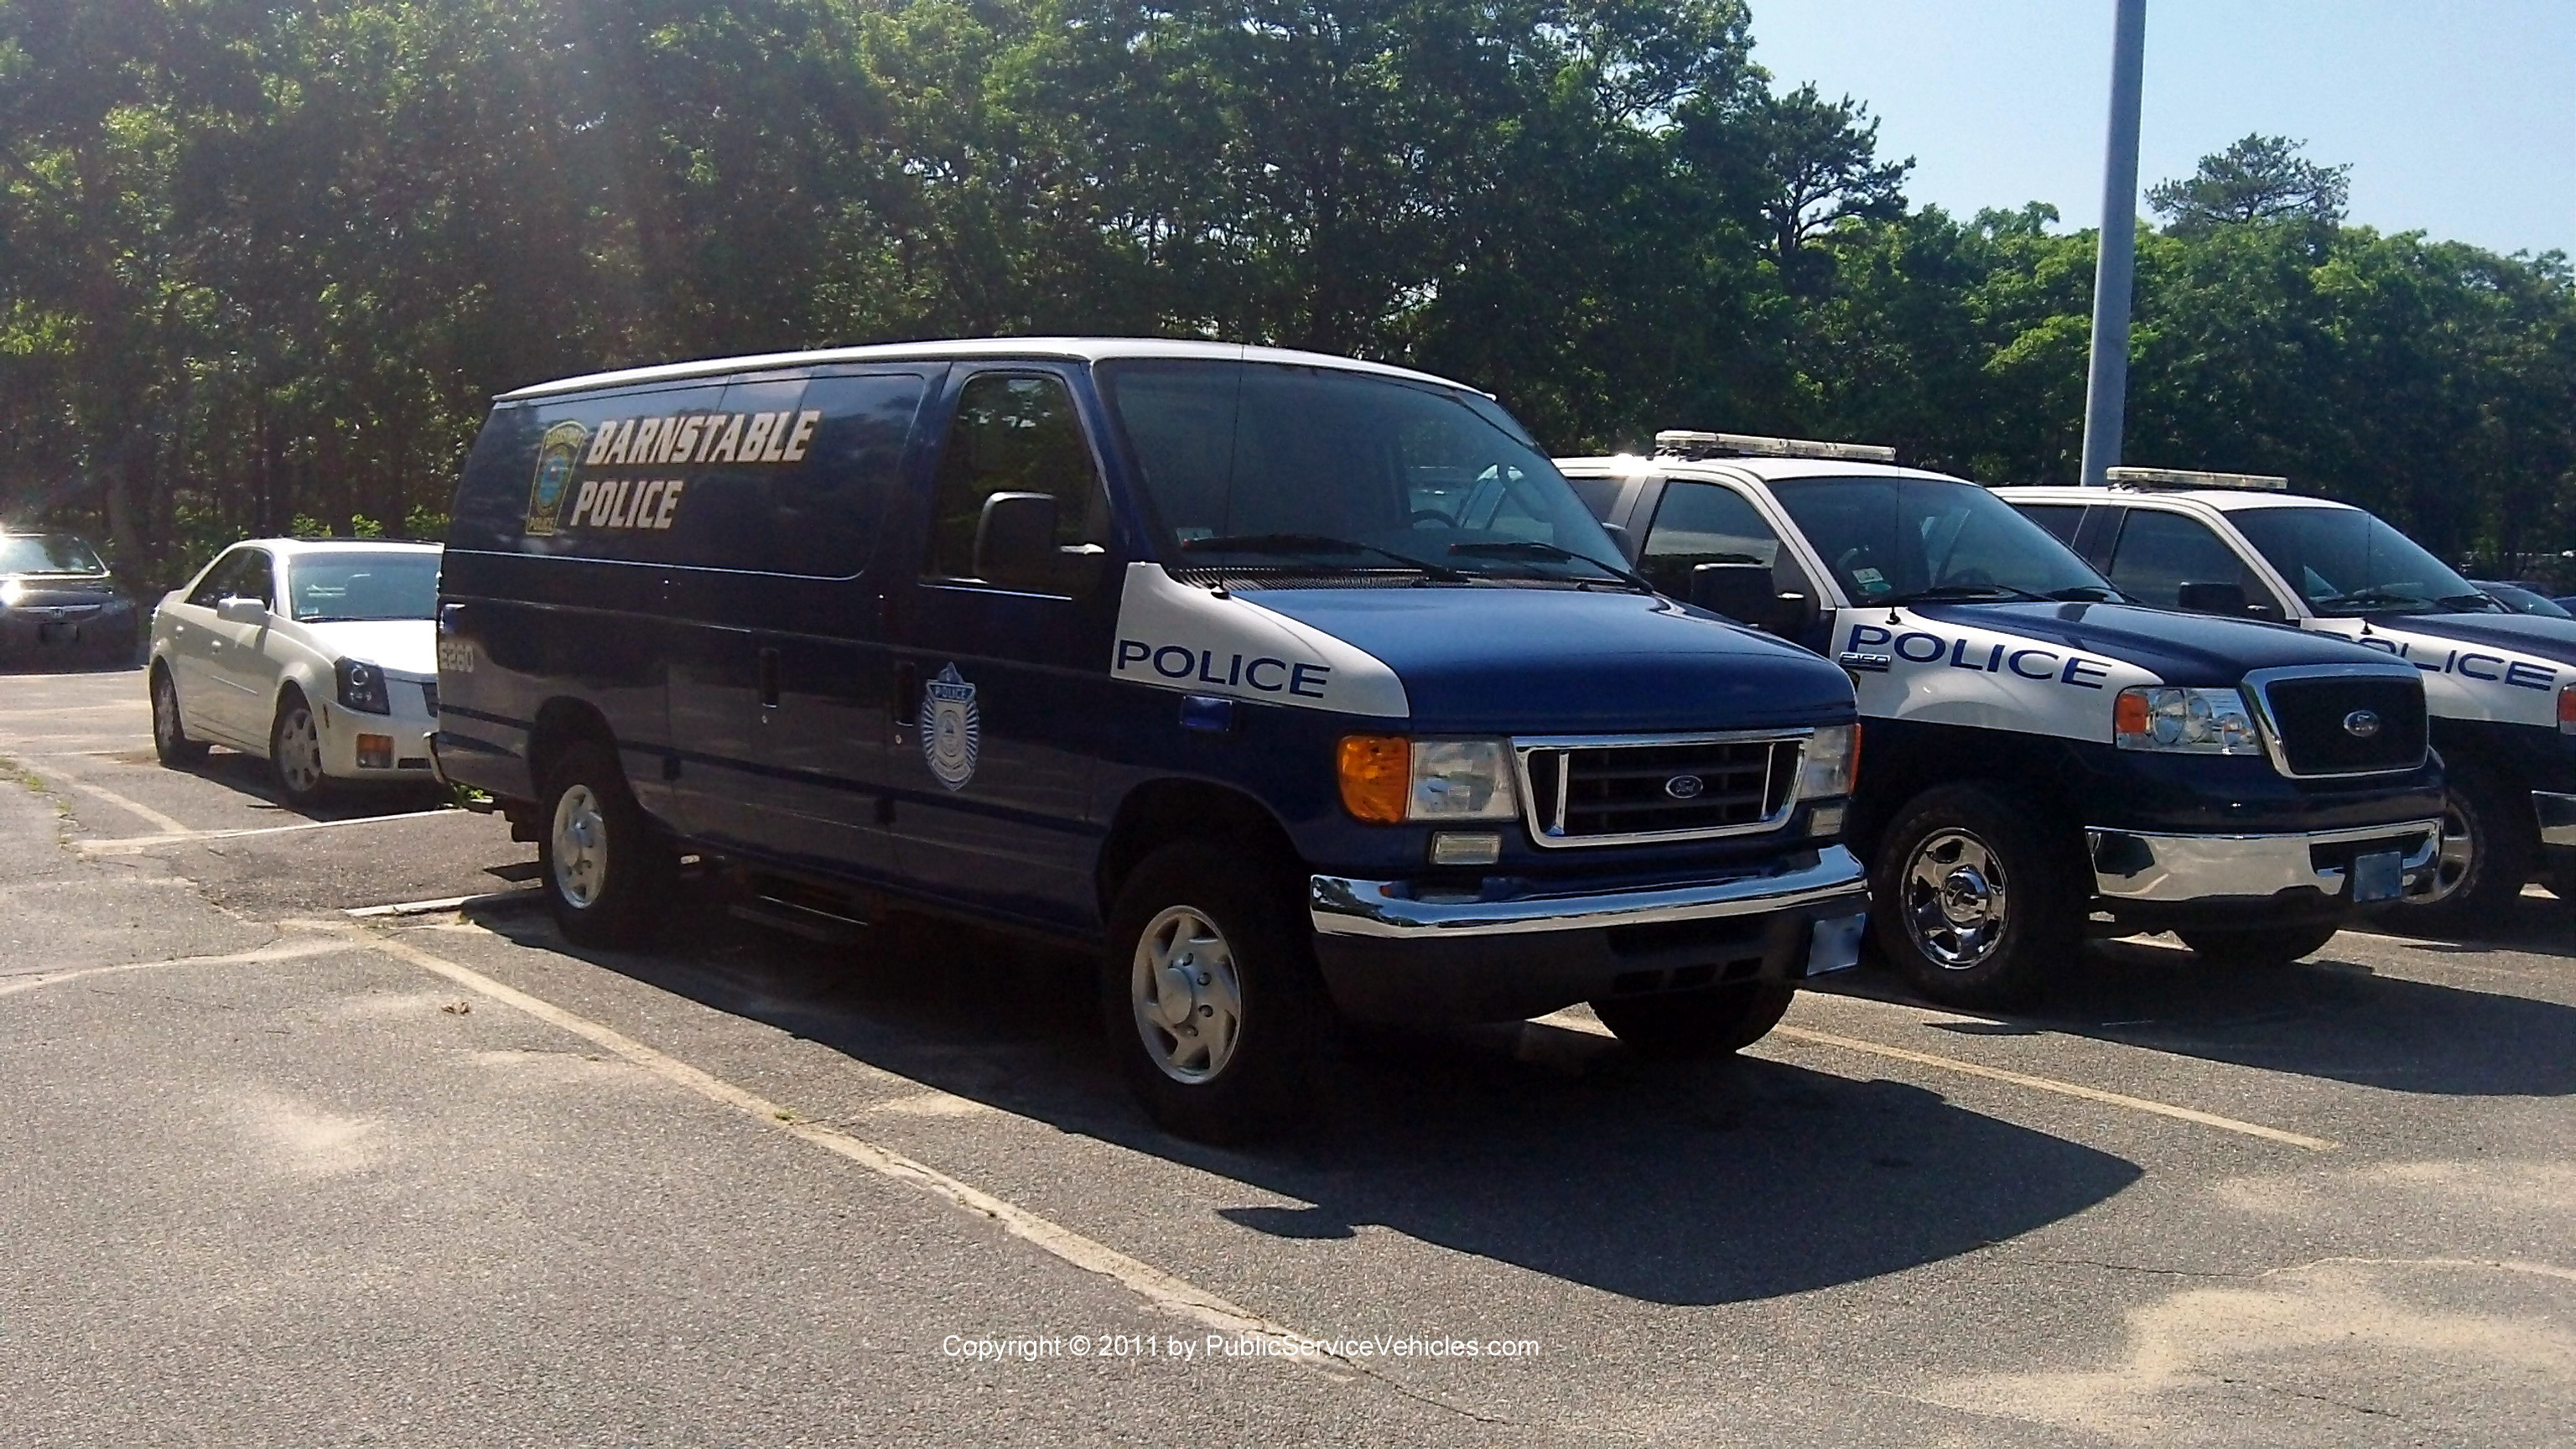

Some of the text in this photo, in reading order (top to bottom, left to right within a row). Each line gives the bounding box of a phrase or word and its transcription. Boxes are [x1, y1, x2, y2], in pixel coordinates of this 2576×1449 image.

[586, 409, 823, 465] BARNSTABLE
[570, 479, 684, 530] POLICE
[1116, 639, 1332, 699] POLICE
[1847, 623, 2112, 690] POLICE
